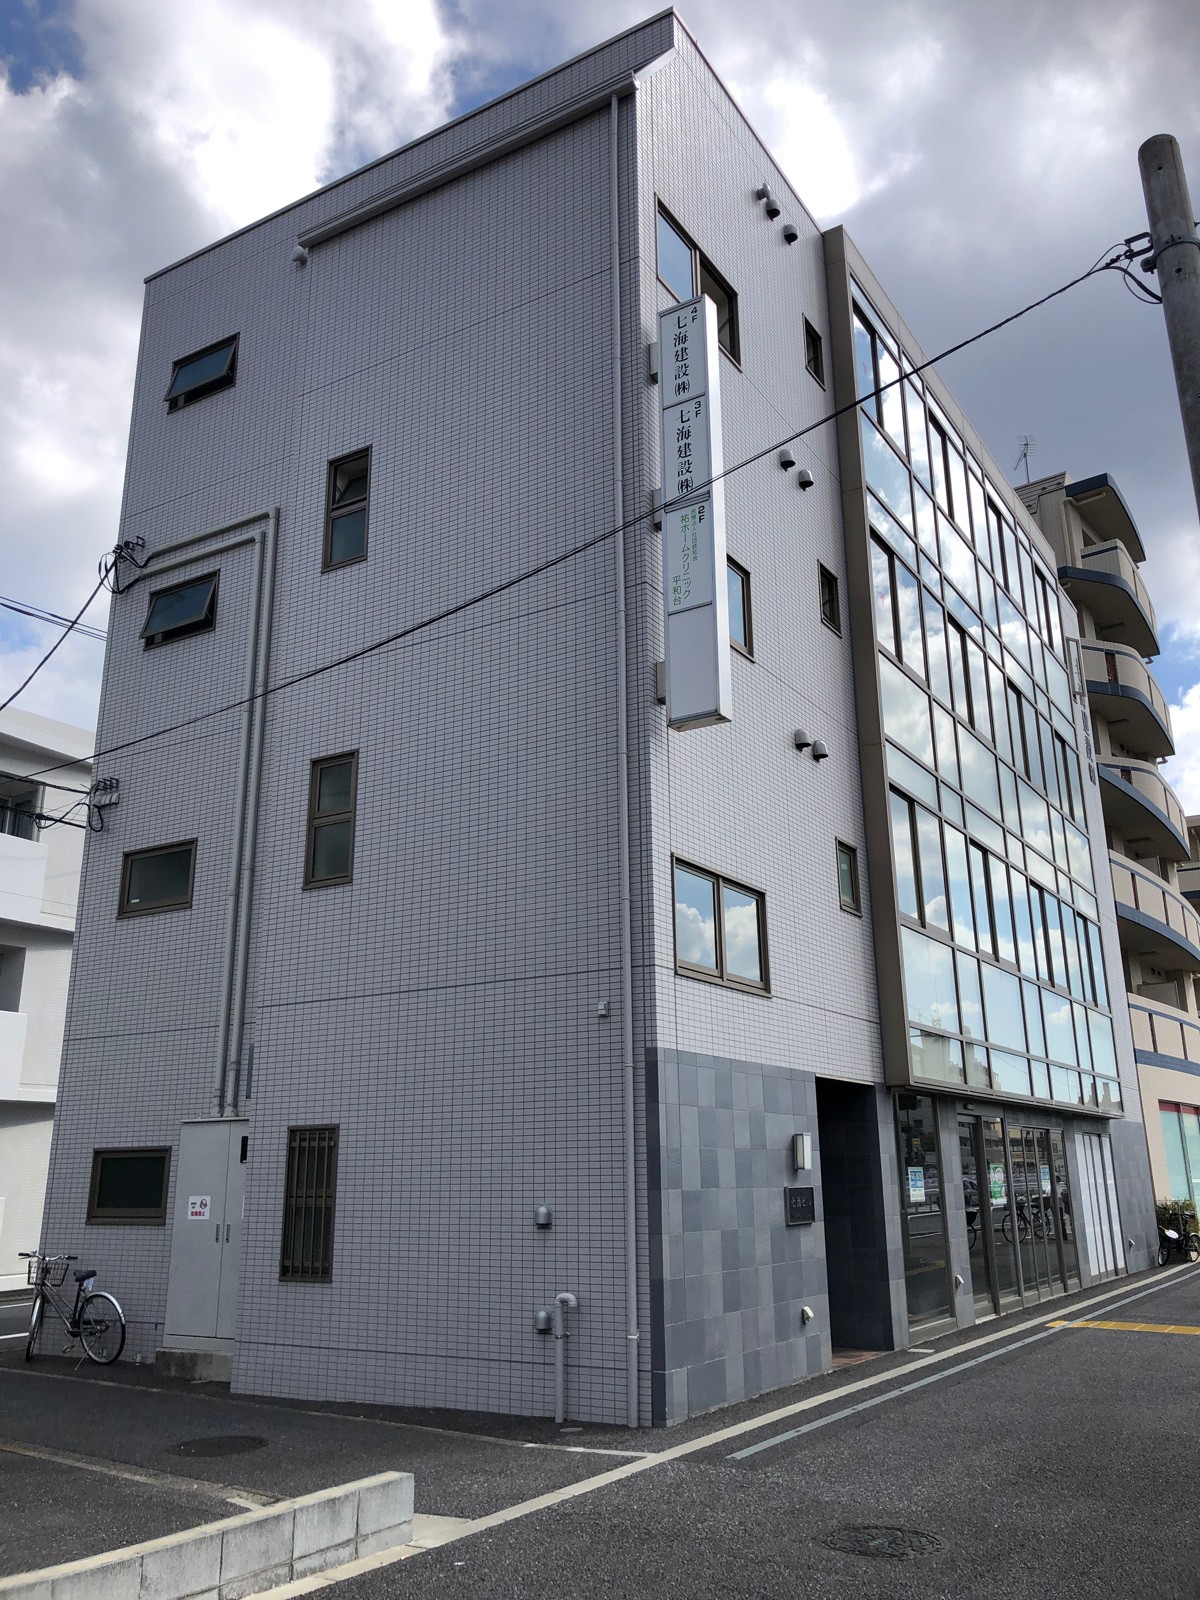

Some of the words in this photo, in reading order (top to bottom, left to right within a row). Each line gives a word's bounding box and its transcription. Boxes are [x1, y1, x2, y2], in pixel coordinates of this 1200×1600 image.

[691, 306, 698, 323] 4F
[694, 401, 702, 418] 3F
[698, 505, 705, 523] 2F
[672, 575, 681, 606] 平和台
